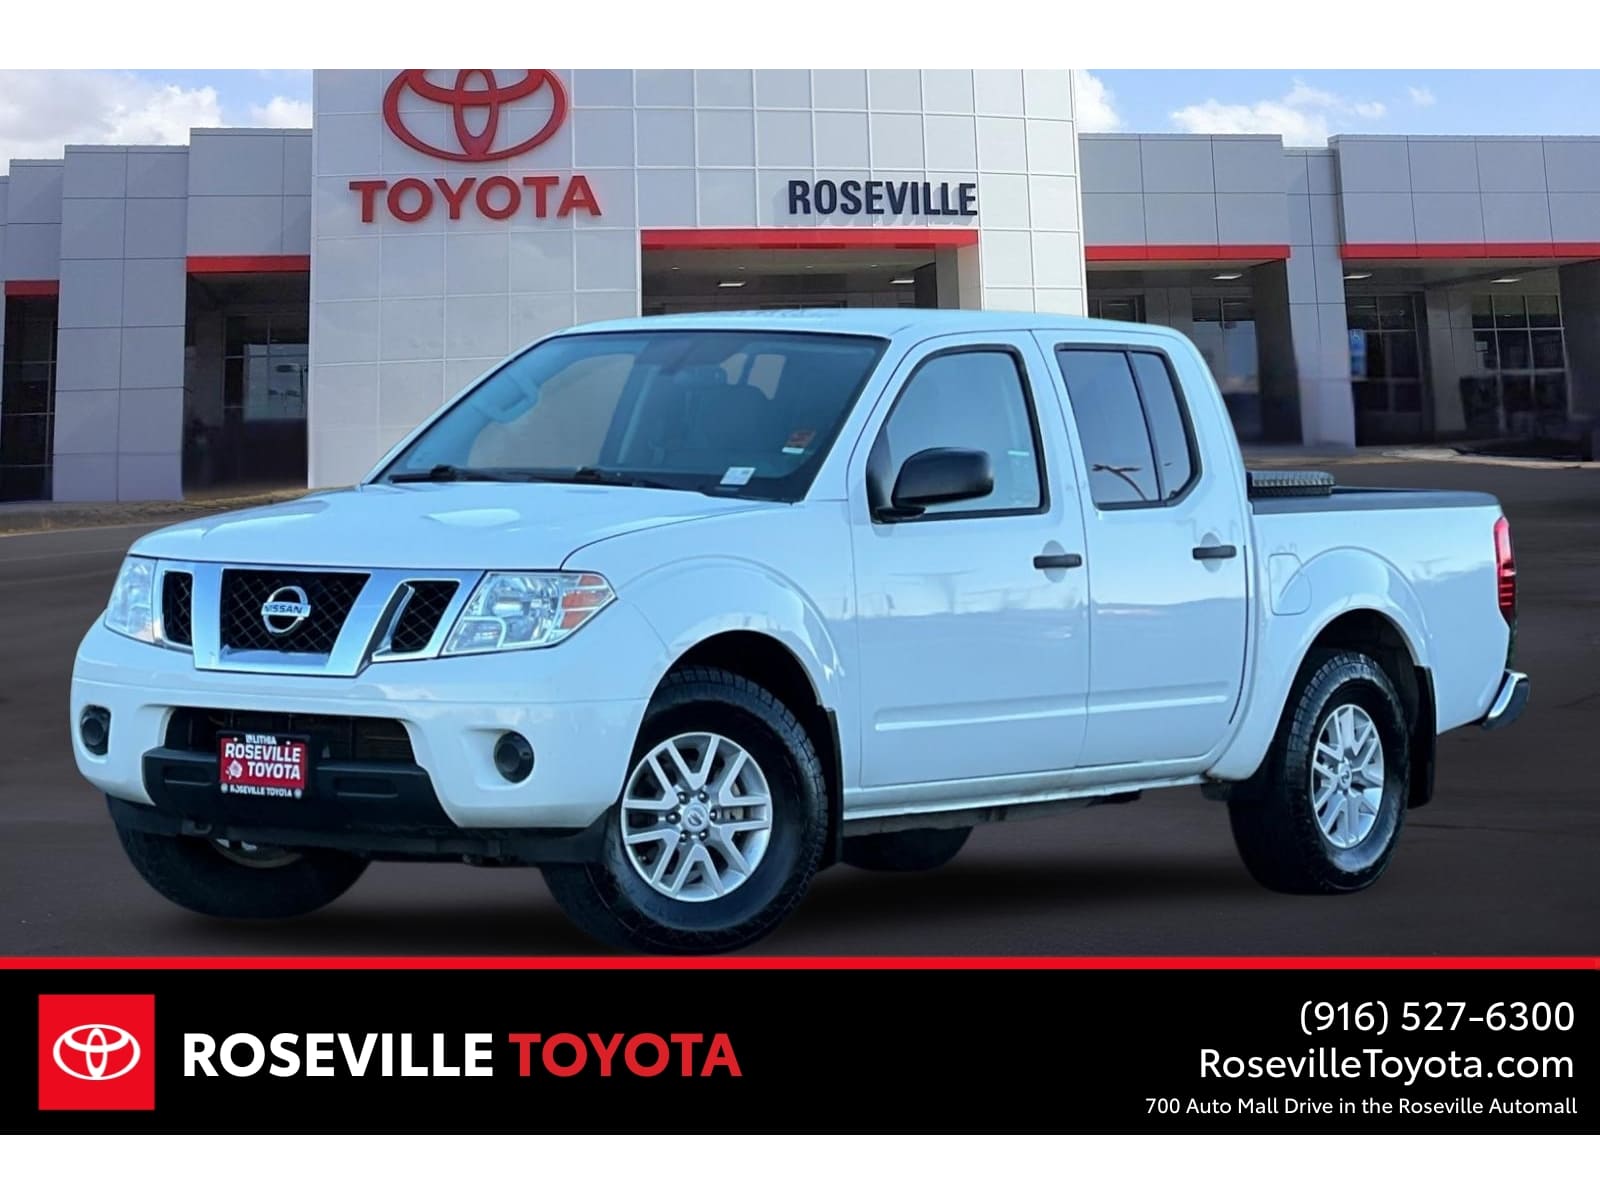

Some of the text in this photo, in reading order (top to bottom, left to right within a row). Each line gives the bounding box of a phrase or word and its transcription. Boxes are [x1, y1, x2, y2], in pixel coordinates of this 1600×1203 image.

[349, 175, 601, 223] TOYOTA
[788, 179, 978, 216] ROSEVILLE
[263, 604, 303, 614] NISSAN
[225, 743, 301, 762] ROSEVILLE
[247, 761, 301, 780] TOYOTA
